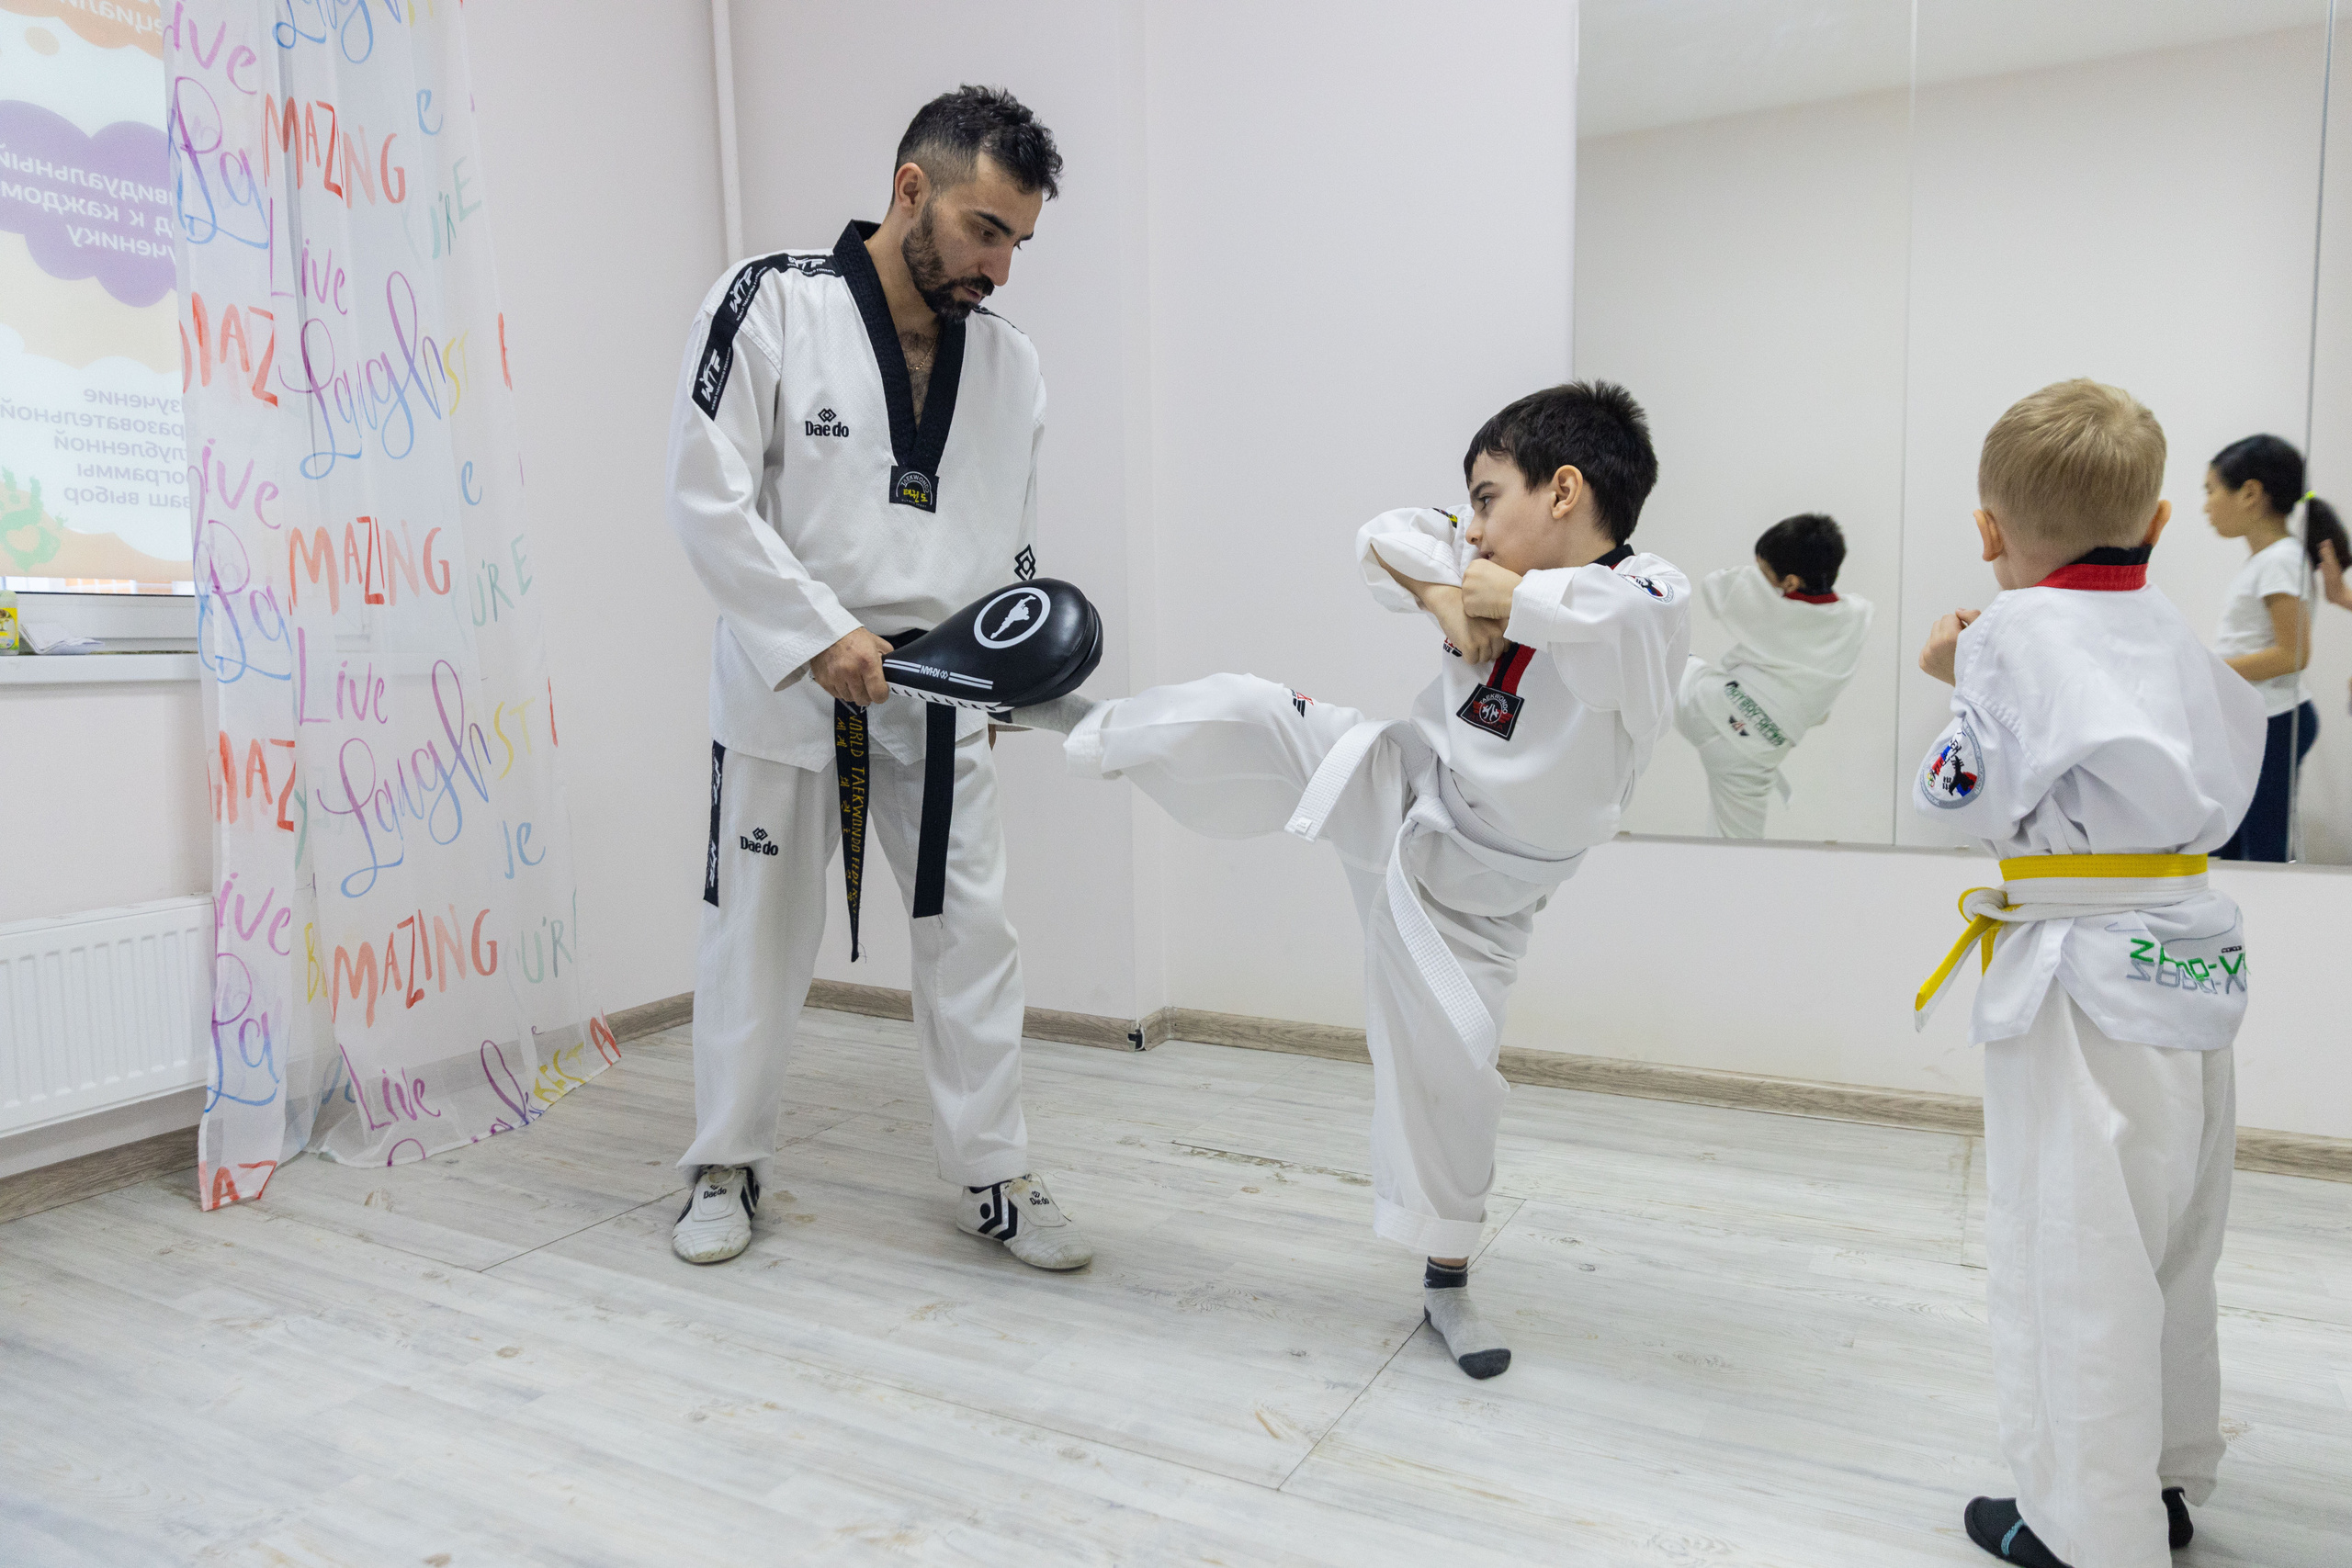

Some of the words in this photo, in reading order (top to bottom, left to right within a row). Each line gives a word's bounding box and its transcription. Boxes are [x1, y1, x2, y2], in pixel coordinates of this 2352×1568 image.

[270, 197, 348, 315] Live
[899, 474, 930, 494] TAEKWONDO
[298, 626, 389, 727] Live
[1478, 693, 1509, 715] TAEKWONDO
[851, 766, 865, 853] TAEKWONDO
[339, 1043, 442, 1132] Live
